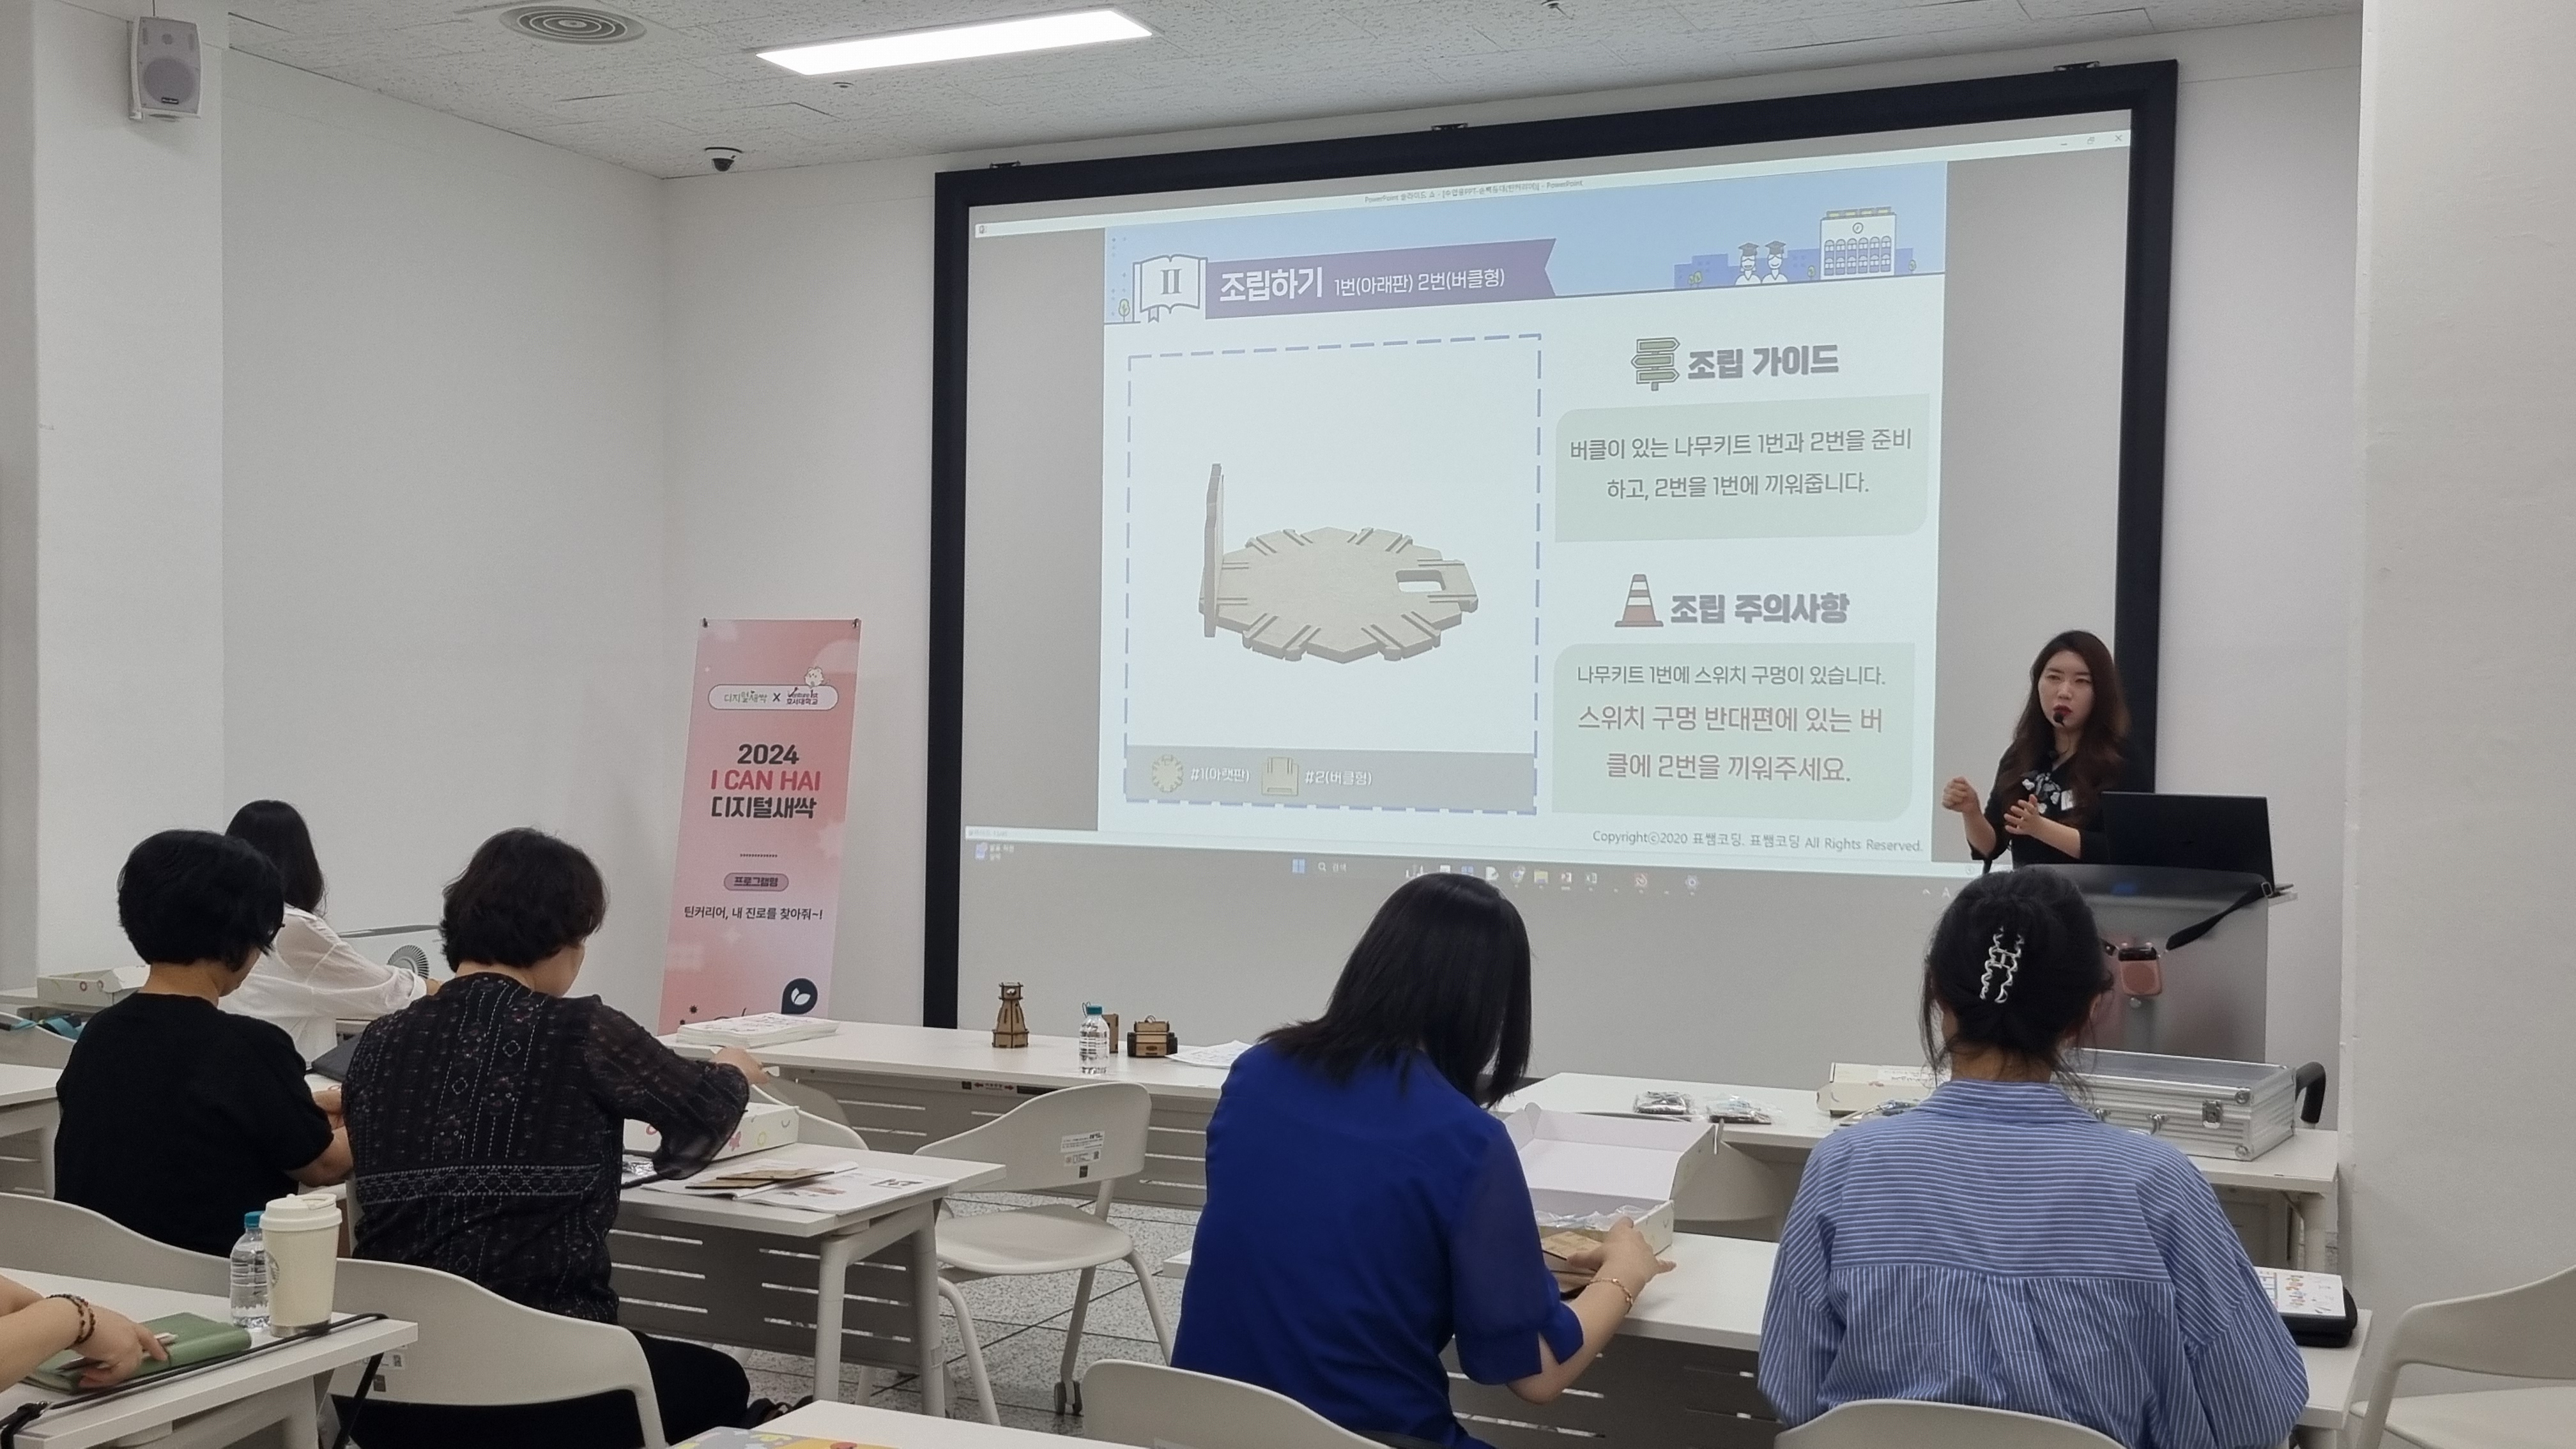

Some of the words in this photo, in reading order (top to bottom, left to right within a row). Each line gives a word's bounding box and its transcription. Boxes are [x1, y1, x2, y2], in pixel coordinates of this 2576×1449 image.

[1546, 180, 1583, 189] PowerPoint
[1220, 267, 1322, 302] 조립하기
[1335, 274, 1413, 296] 1번(아래판)
[1418, 268, 1505, 291] 2번(버클형)
[1687, 348, 1743, 380] 조립
[1753, 344, 1839, 376] 가이드
[1570, 440, 1625, 461] 버클이
[1632, 437, 1668, 459] 있는
[1675, 433, 1751, 457] 나무키트
[1758, 432, 1804, 455] 1번과
[1811, 430, 1865, 453] 2번을
[1871, 428, 1911, 451] 준비
[1607, 478, 1648, 501] 하고,
[1655, 477, 1706, 498] 2번을
[1713, 475, 1758, 497] 1번에
[1765, 472, 1869, 496] 끼워줍니다.
[1671, 594, 1725, 624] 조립
[1735, 592, 1850, 624] 주의사항
[1577, 666, 1644, 685] 나무키트
[1650, 666, 1689, 685] 1번에
[1695, 666, 1745, 685] 스위치
[1751, 666, 1804, 685] 구멍이
[1809, 666, 1885, 686] 있습니다.
[1578, 706, 1644, 730] 스위치
[1653, 707, 1696, 730] 구멍
[1705, 707, 1797, 732] 반대편에
[1806, 707, 1851, 733] 있는
[1861, 709, 1882, 733] 버
[737, 744, 799, 764] 2024
[1305, 770, 1372, 786] #2(버클형)
[1607, 753, 1650, 779] 클에
[1659, 754, 1720, 779] 2번을
[1728, 756, 1850, 783] 끼워주세요.
[710, 770, 717, 789] I
[724, 770, 773, 790] CAN
[780, 770, 821, 791] HAI
[711, 797, 816, 818] 디지털새싹
[1750, 834, 1800, 849] 표쌤코딩
[1804, 837, 1820, 848] All
[1825, 838, 1861, 852] Rights
[1866, 839, 1923, 852] Reserved.
[733, 877, 778, 887] 프로그램명
[684, 906, 728, 919] 틴커리어,
[732, 907, 742, 919] 내
[746, 908, 777, 919] 진로를
[780, 908, 823, 921] 찾아줘~!
